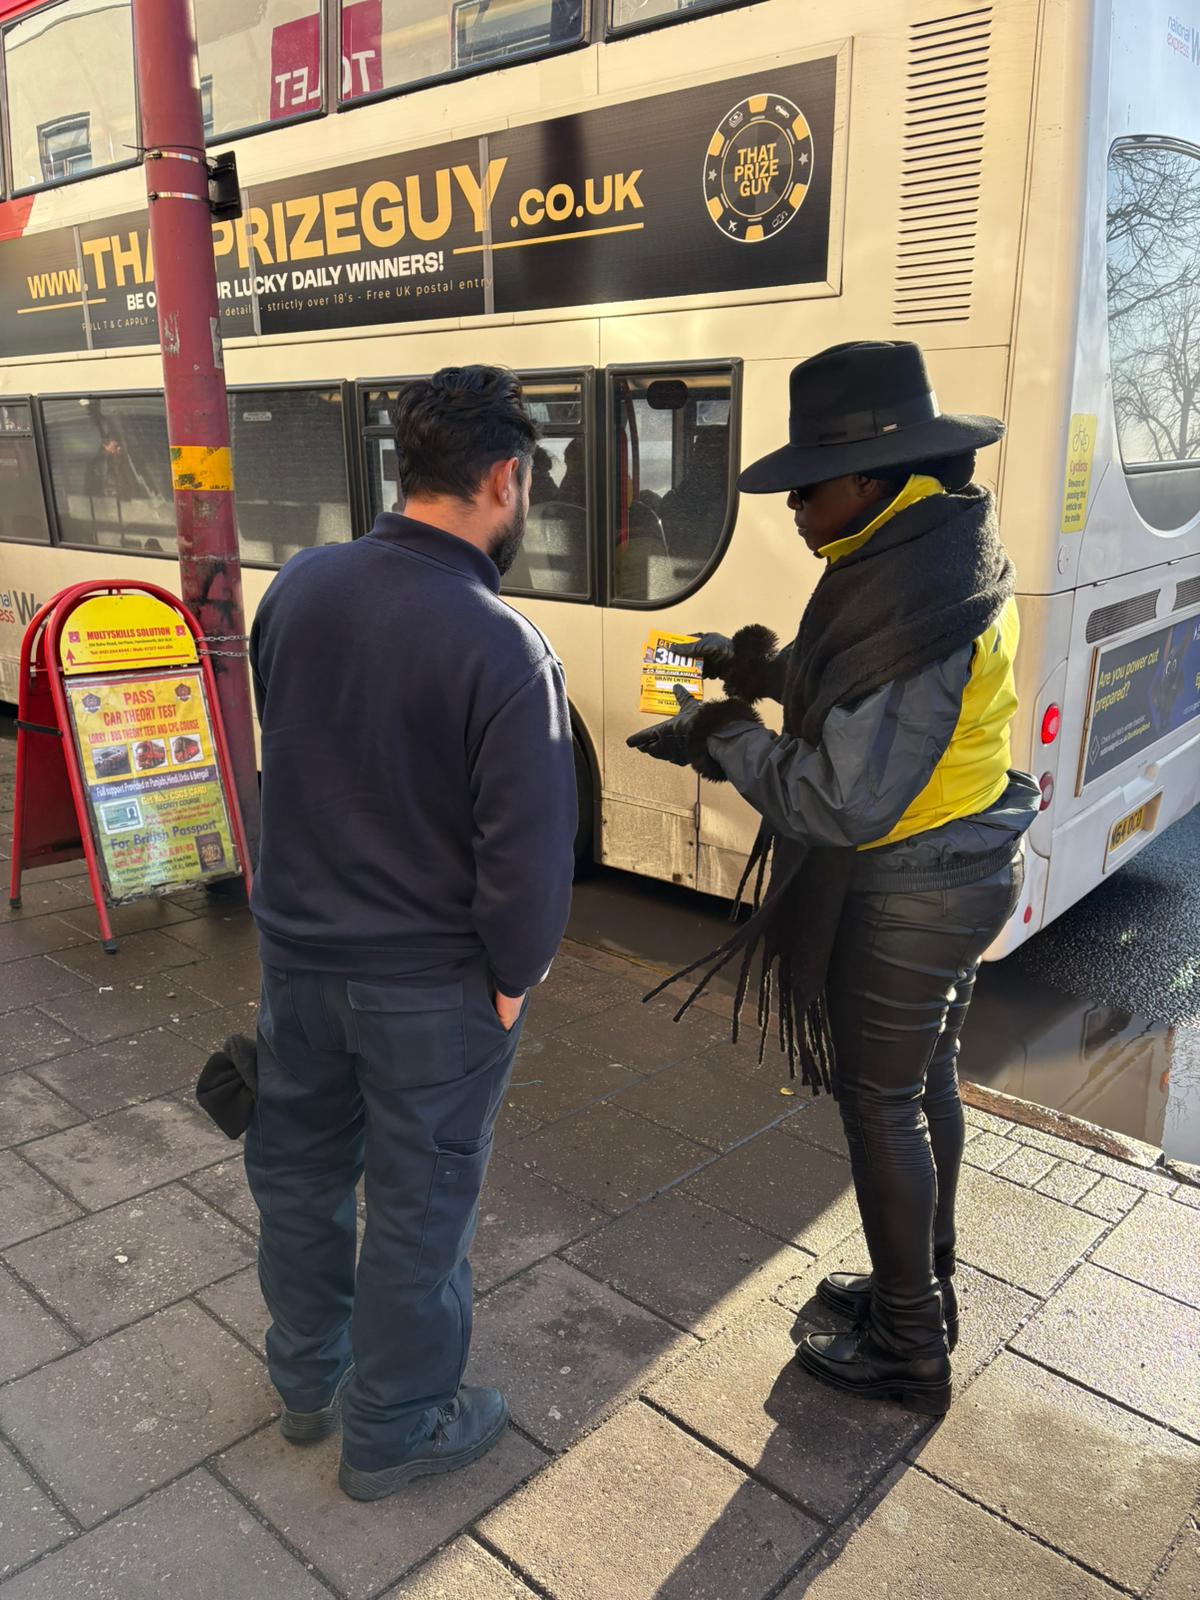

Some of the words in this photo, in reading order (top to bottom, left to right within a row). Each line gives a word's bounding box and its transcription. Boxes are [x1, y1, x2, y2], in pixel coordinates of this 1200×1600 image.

[737, 143, 777, 166] THAT
[734, 158, 780, 183] PRIZE
[740, 176, 772, 197] GUY
[127, 293, 145, 311] BE
[233, 272, 288, 299] LUCKY
[292, 264, 343, 291] DAILY
[346, 250, 444, 283] WINNERS!
[124, 316, 149, 327] APPLY
[225, 303, 252, 317] detail
[267, 293, 304, 313] strictly
[307, 296, 329, 308] over
[333, 291, 353, 305] 18's
[366, 288, 391, 301] Free
[395, 285, 412, 298] UK
[416, 279, 453, 297] postal
[459, 276, 494, 291] entry
[136, 626, 171, 638] SOLUTION
[1098, 671, 1110, 689] Are
[1111, 667, 1125, 687] you
[1125, 657, 1147, 679] power
[1147, 648, 1160, 666] cut
[123, 689, 156, 705] PASS
[1094, 680, 1131, 717] prepared?
[103, 710, 122, 726] CAR
[124, 706, 157, 724] THEORY
[158, 703, 177, 720] TEST
[123, 728, 143, 740] THEORY
[144, 725, 156, 737] TEST
[157, 723, 168, 735] AND
[180, 719, 200, 732] COURSE
[96, 786, 106, 797] Full
[106, 782, 124, 797] support
[124, 779, 145, 792] Provided
[110, 837, 130, 850] For
[134, 829, 169, 846] British
[172, 819, 217, 838] Passport
